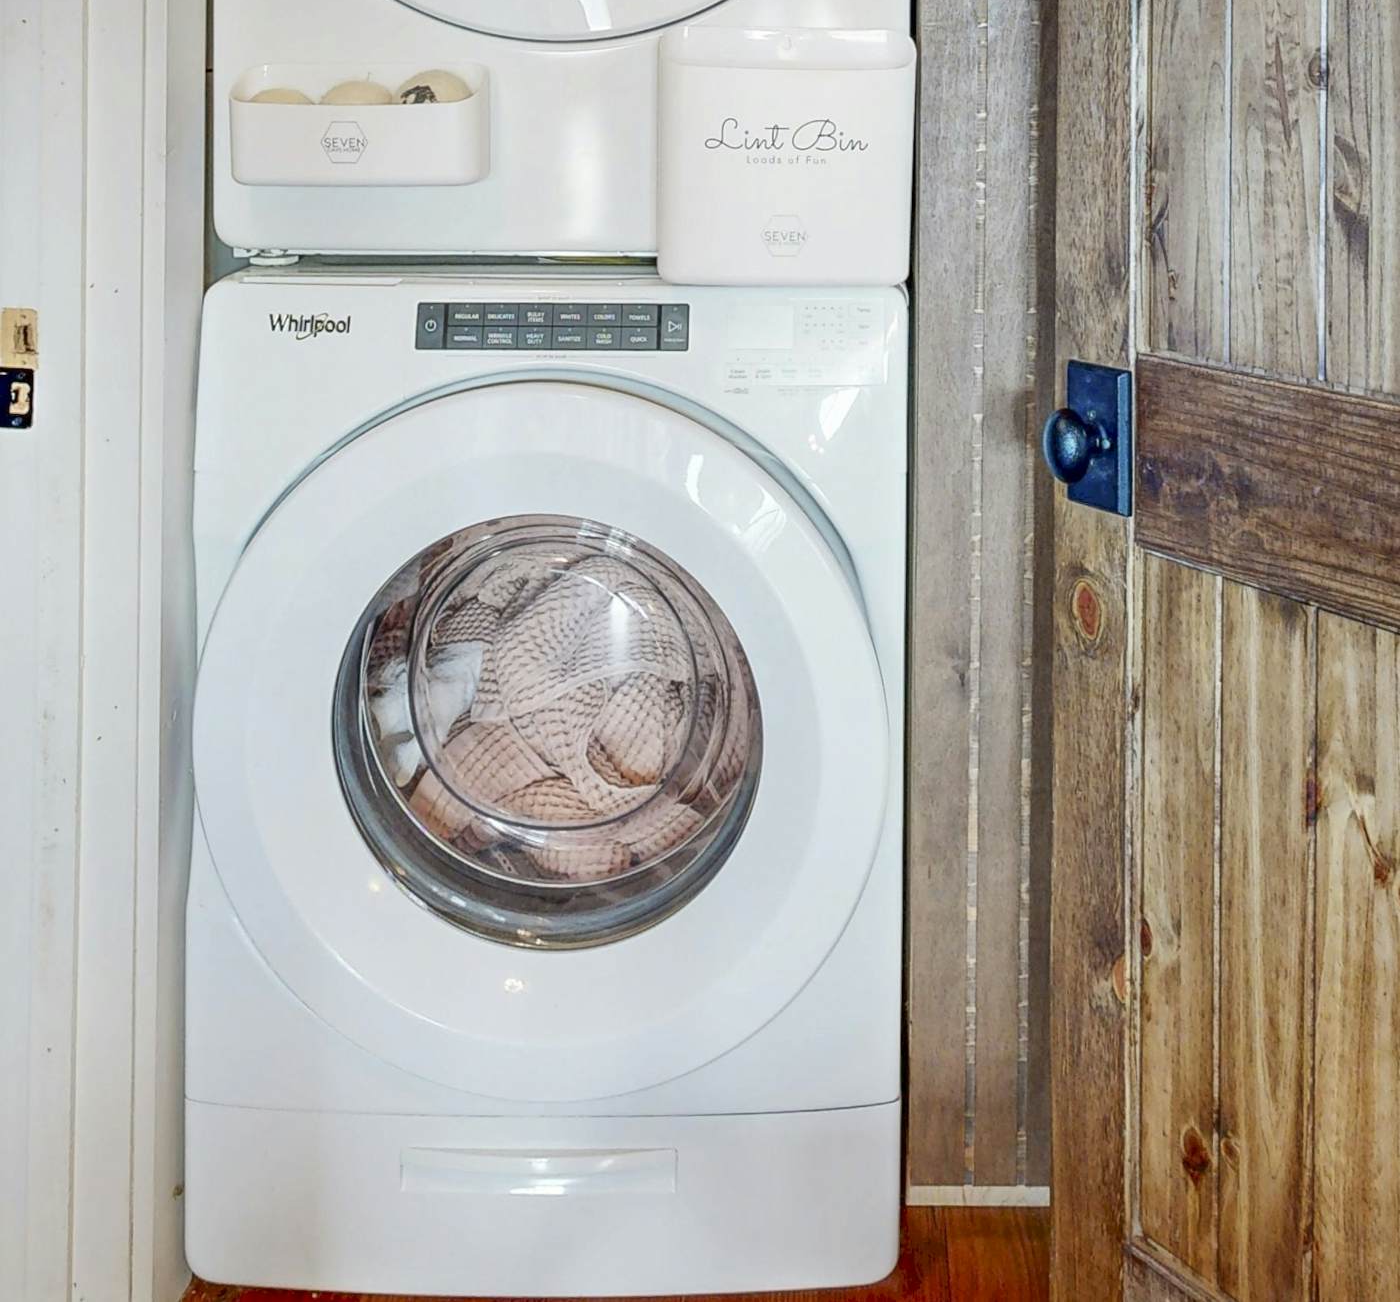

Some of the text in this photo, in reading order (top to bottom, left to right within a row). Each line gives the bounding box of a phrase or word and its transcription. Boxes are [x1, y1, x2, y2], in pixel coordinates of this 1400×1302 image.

[704, 117, 869, 151] Lint Bin
[323, 137, 366, 148] SEVEN
[746, 154, 827, 165] Loads of Fun
[764, 230, 807, 242] SEVEN
[269, 312, 351, 340] Whirlpool
